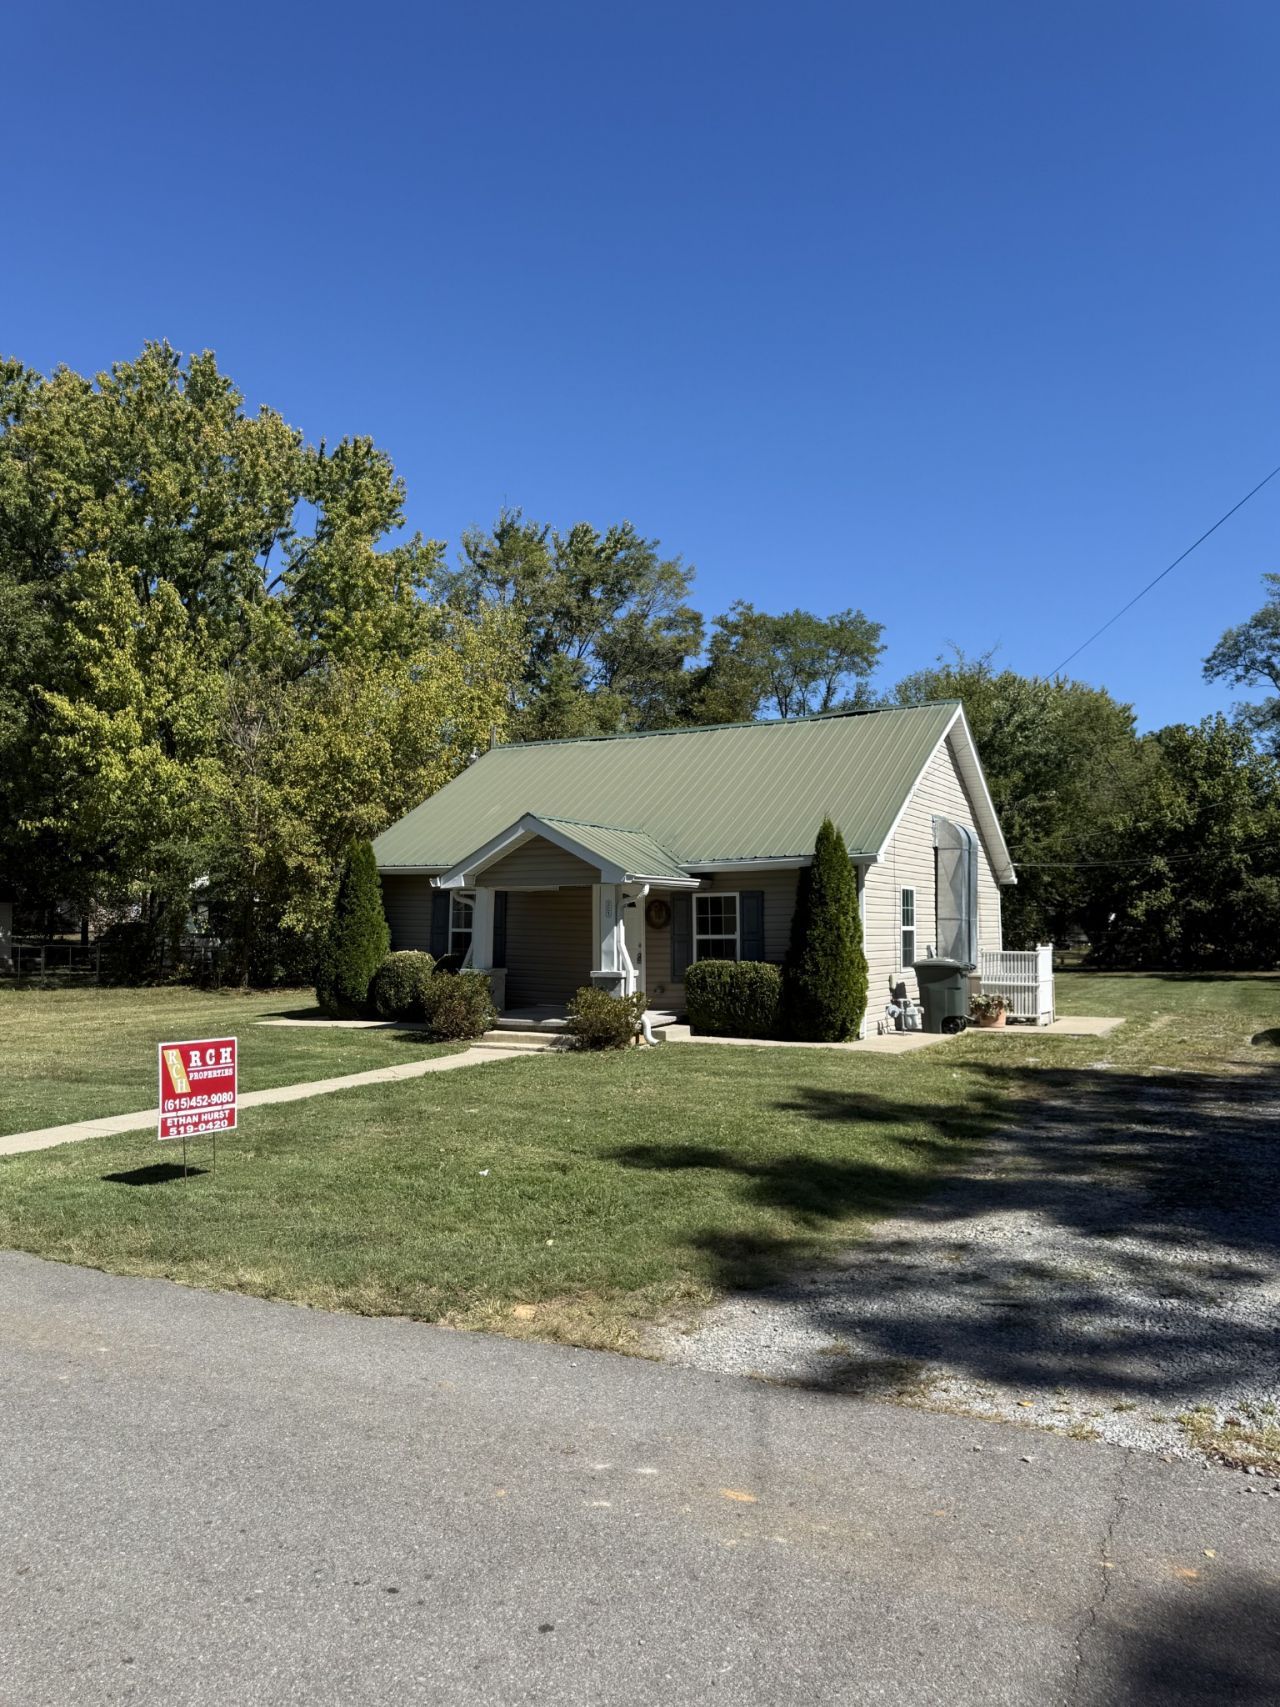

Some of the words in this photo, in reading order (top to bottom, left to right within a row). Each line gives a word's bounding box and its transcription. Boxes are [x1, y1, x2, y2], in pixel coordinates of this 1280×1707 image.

[189, 1047, 232, 1067] RCH
[189, 1068, 233, 1080] PROPERTIES
[167, 1115, 199, 1126] ETHAN
[201, 1110, 230, 1121] HURST
[169, 1119, 228, 1135] 519-0420
